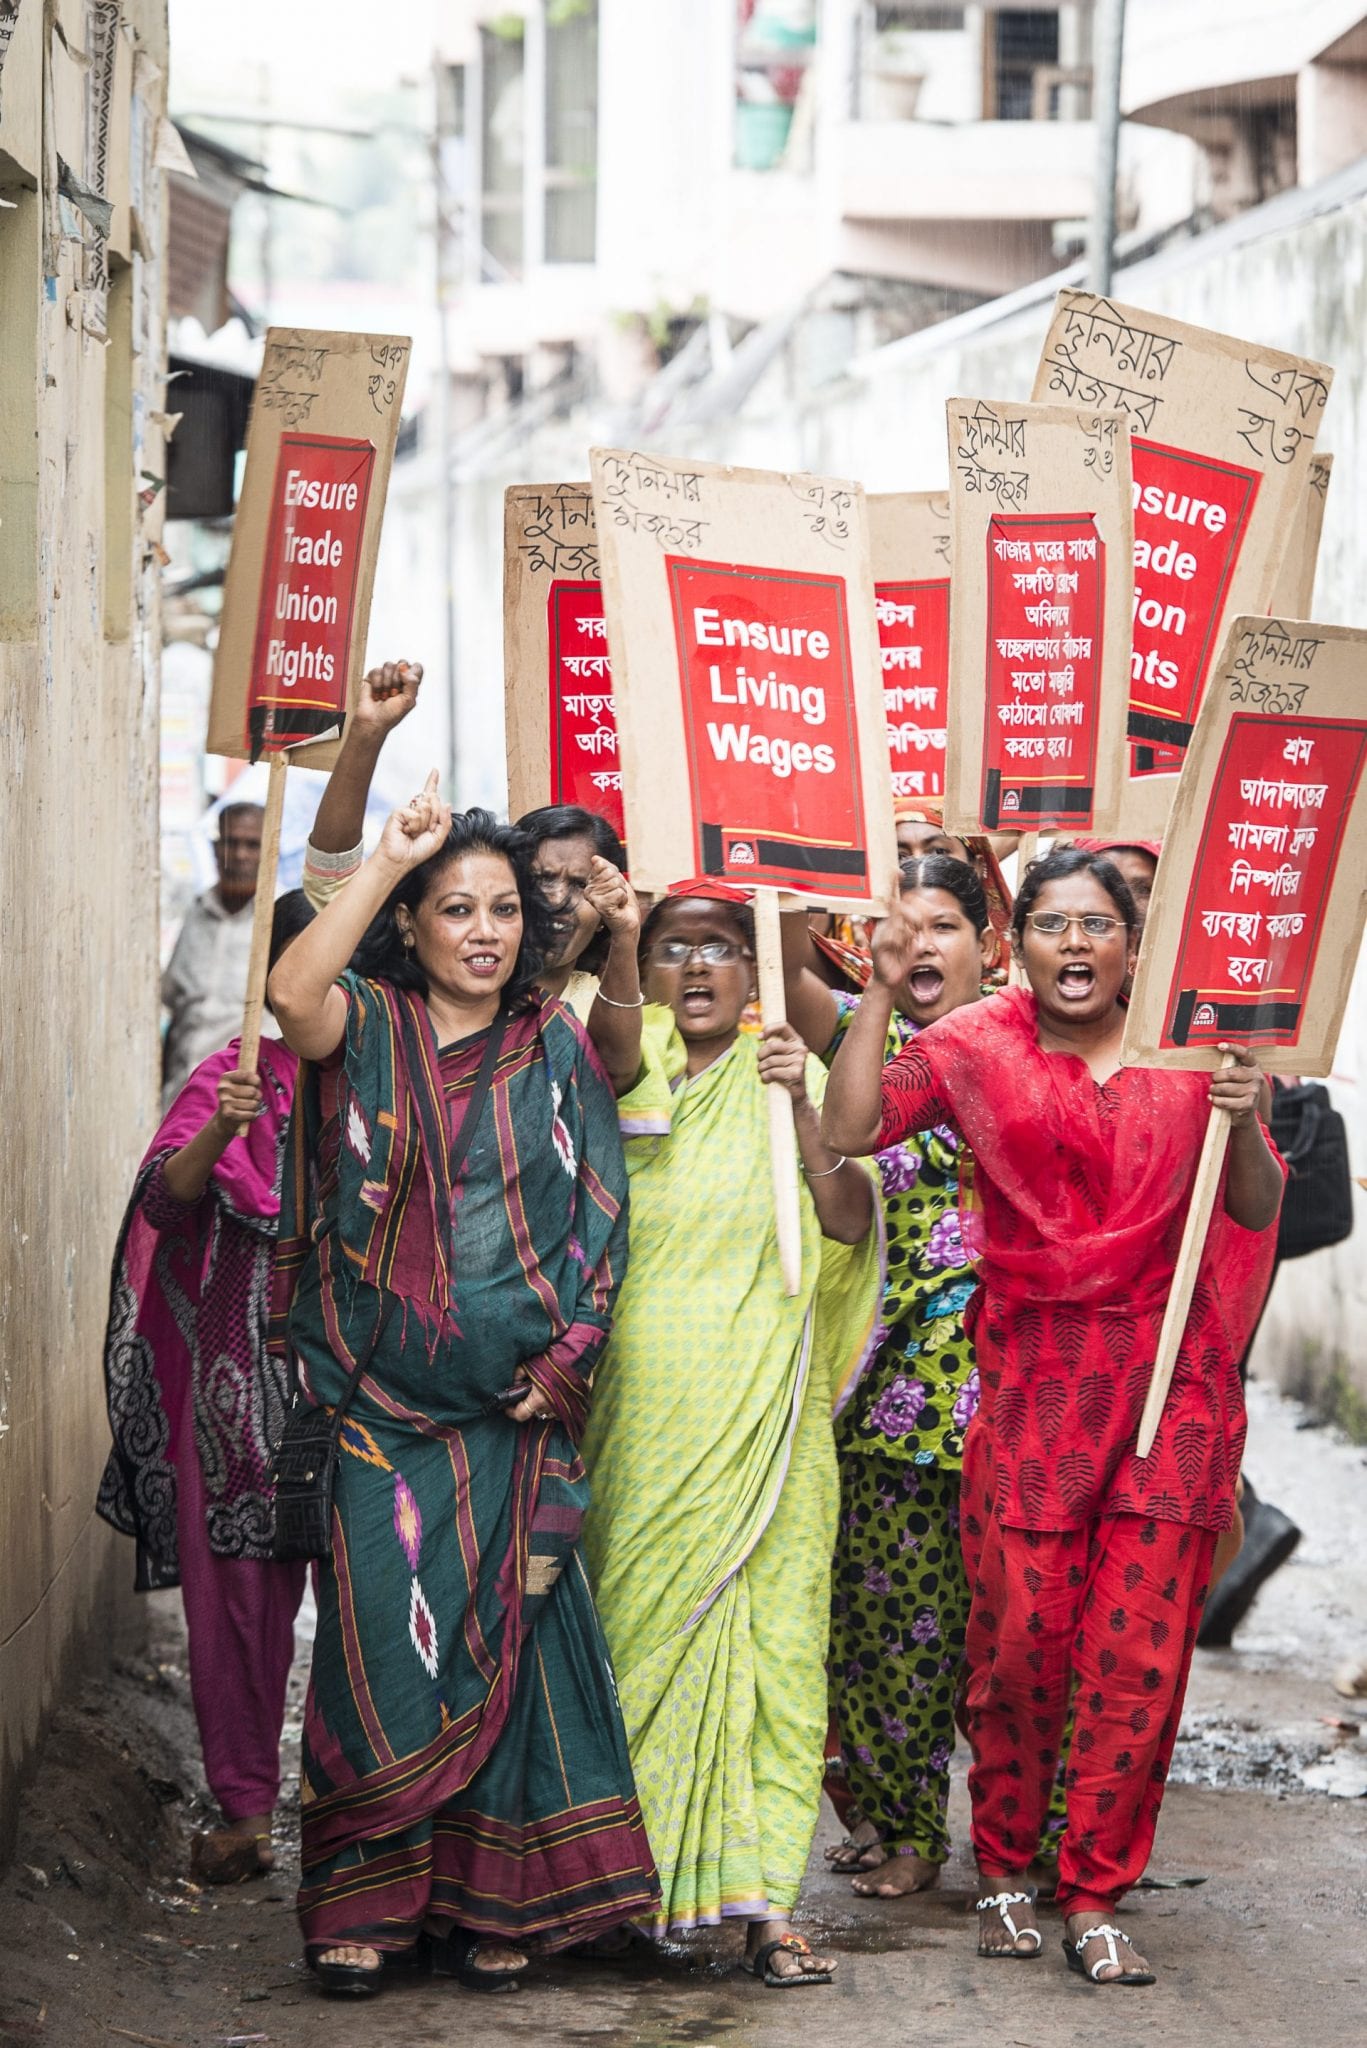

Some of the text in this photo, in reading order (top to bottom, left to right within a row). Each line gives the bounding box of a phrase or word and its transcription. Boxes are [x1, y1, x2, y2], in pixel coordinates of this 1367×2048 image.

[371, 344, 408, 370] এক
[1055, 299, 1183, 381] দুনিয়ার
[368, 374, 396, 415] হও
[1246, 359, 1328, 418] এক
[958, 401, 1028, 458] দুনিয়ার
[1077, 415, 1118, 446] এক
[1237, 408, 1314, 464] হও
[603, 452, 704, 503] দুনিয়ার
[1084, 448, 1113, 481] হও
[284, 470, 358, 511] Ensure
[788, 480, 858, 515] এক
[284, 526, 343, 567] Trade
[993, 537, 1097, 562] বাজার দরের সাথে
[1133, 540, 1197, 581] ade
[1012, 566, 1079, 594] সঙ্গতি রেখে
[275, 583, 337, 625] Union
[1133, 587, 1186, 636] ion
[574, 617, 607, 639] সর
[694, 607, 830, 659] Ensure
[266, 639, 335, 687] Rights
[880, 646, 923, 670] দের
[1062, 632, 1092, 660] বাঁচার
[1234, 620, 1325, 678] দুনিয়ার
[1011, 670, 1046, 693] মতো
[1130, 643, 1179, 689] hts
[709, 665, 826, 725] Living
[883, 685, 939, 713] রাপদ
[997, 696, 1084, 726] কাঠামো ঘোষণা
[575, 726, 620, 755] অধি
[706, 722, 836, 778] Wages
[1004, 738, 1045, 758] করতে
[1283, 736, 1315, 766] শ্রম
[590, 771, 622, 793] কর
[1240, 777, 1328, 809] আদালতের
[1228, 821, 1318, 856] মামলা দ্রুত
[1230, 859, 1301, 896] নিষ্পত্তির
[1201, 911, 1307, 946] ব্যবস্থা করতে
